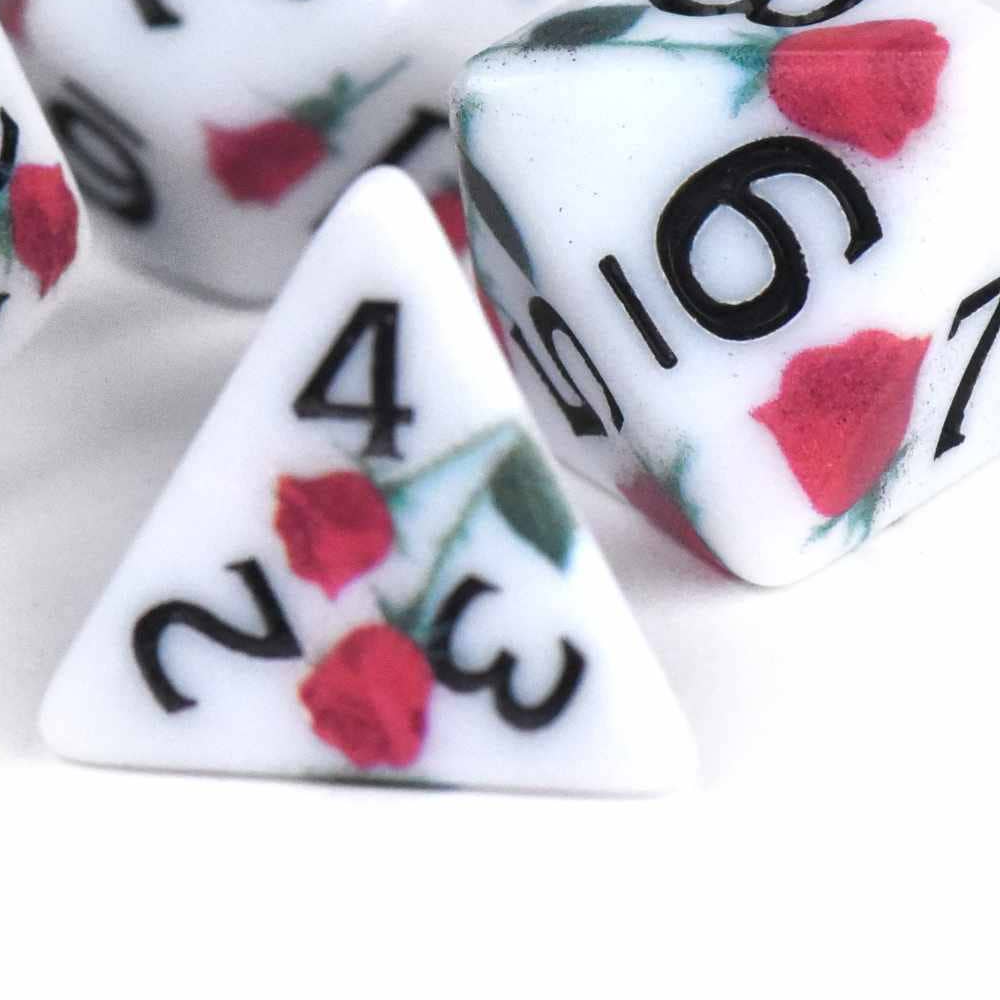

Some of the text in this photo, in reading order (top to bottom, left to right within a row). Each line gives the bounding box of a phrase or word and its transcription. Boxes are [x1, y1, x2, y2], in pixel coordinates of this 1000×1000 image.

[293, 299, 415, 461] 4
[131, 556, 305, 715] 2
[429, 574, 587, 733] 3
